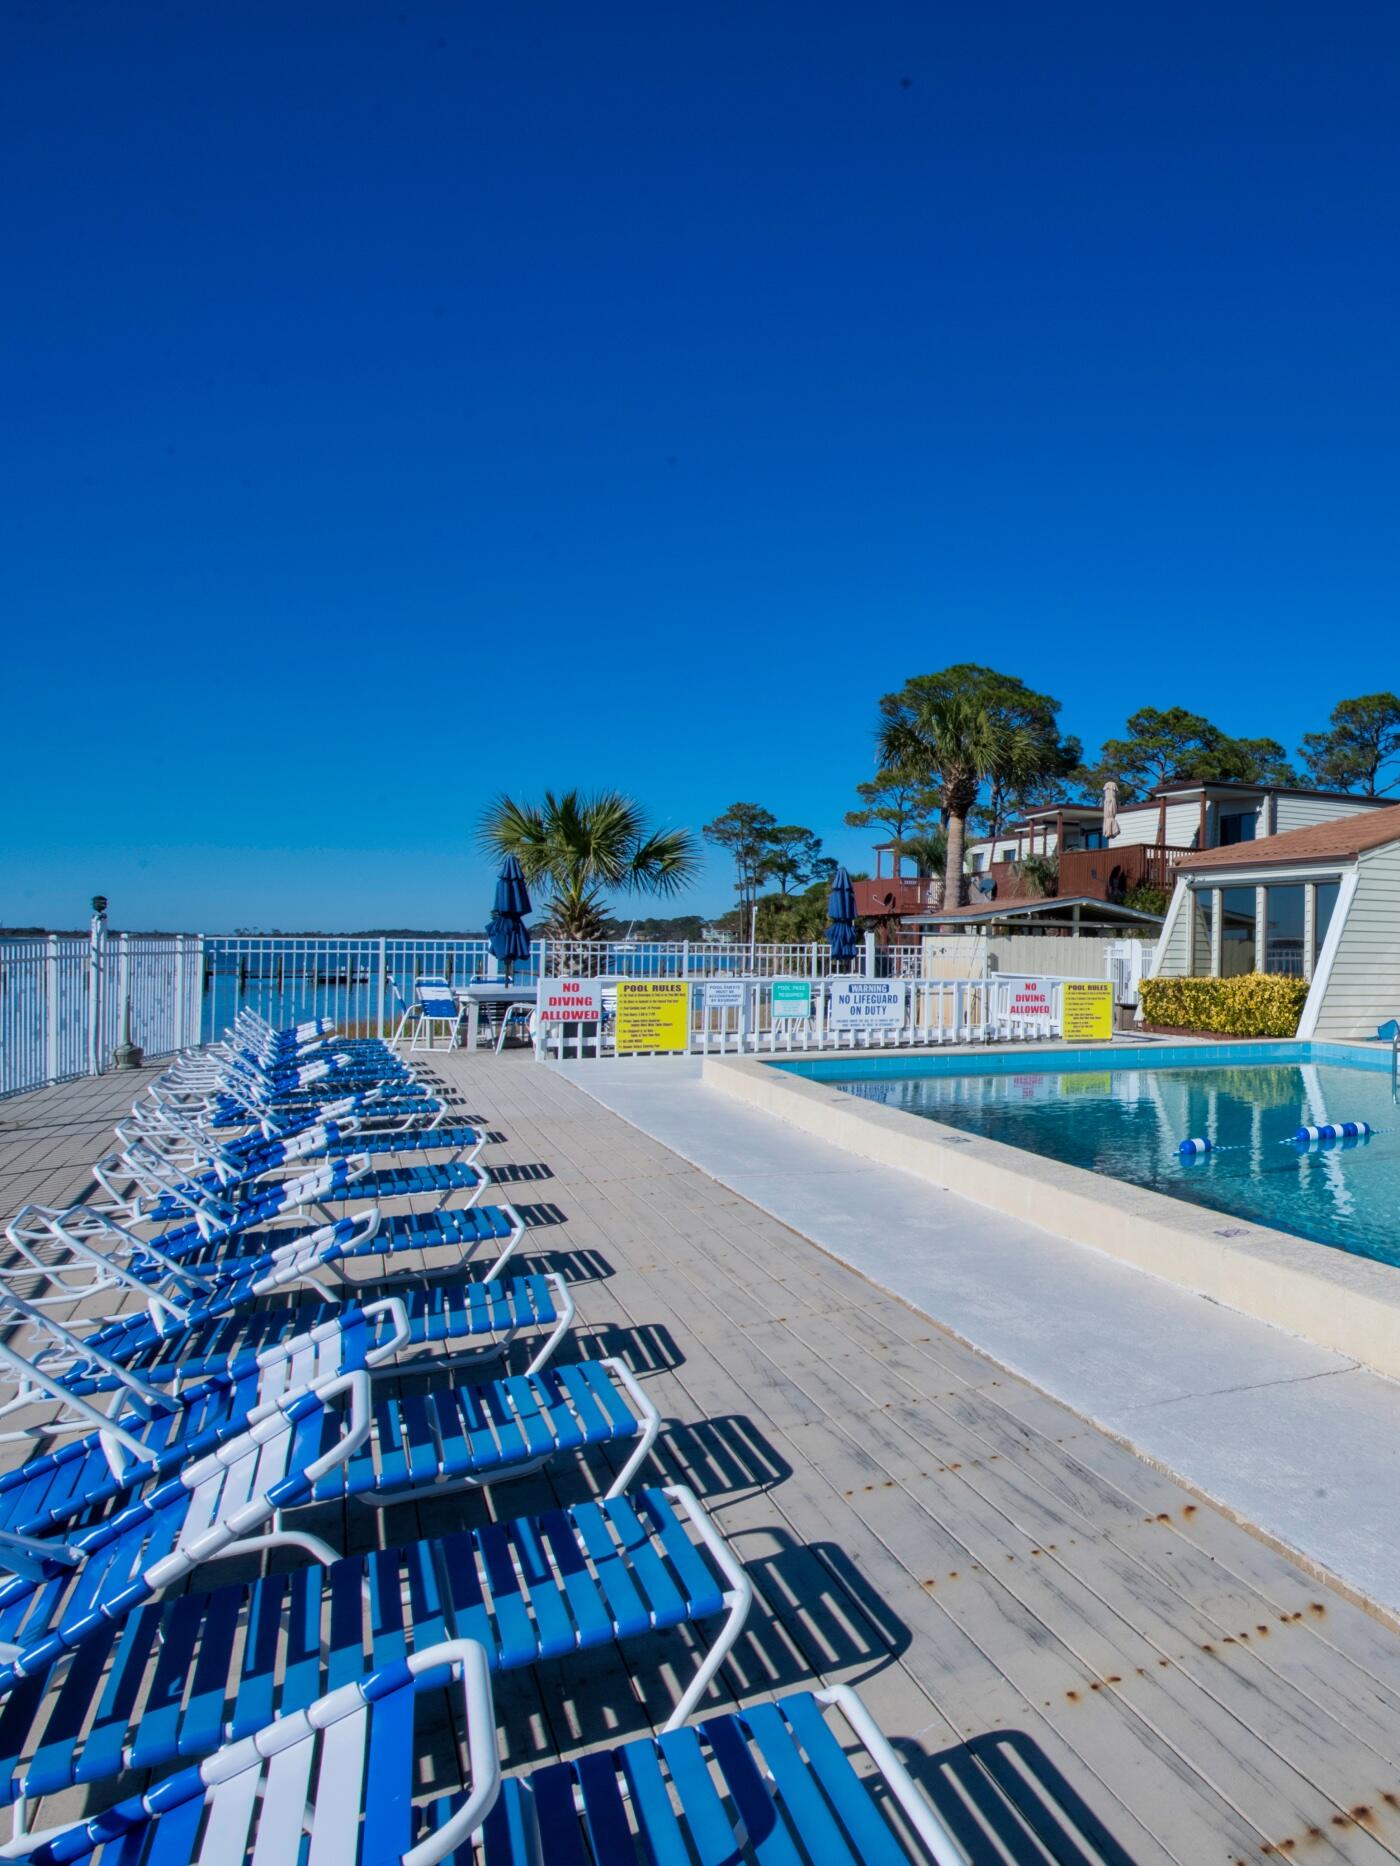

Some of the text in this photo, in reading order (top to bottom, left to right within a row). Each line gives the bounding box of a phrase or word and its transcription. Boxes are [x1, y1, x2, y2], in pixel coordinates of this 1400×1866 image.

[562, 983, 580, 993] NO
[652, 984, 682, 992] RULES
[851, 984, 887, 993] WARNING
[1025, 983, 1037, 991] NO
[548, 996, 593, 1006] DIVING
[839, 994, 898, 1004] NO LIFEGUARD
[1015, 994, 1046, 1002] DIVING
[850, 1005, 887, 1015] ON DUTY
[1010, 1005, 1050, 1014] ALLOWED
[541, 1010, 599, 1020] ALLOWED
